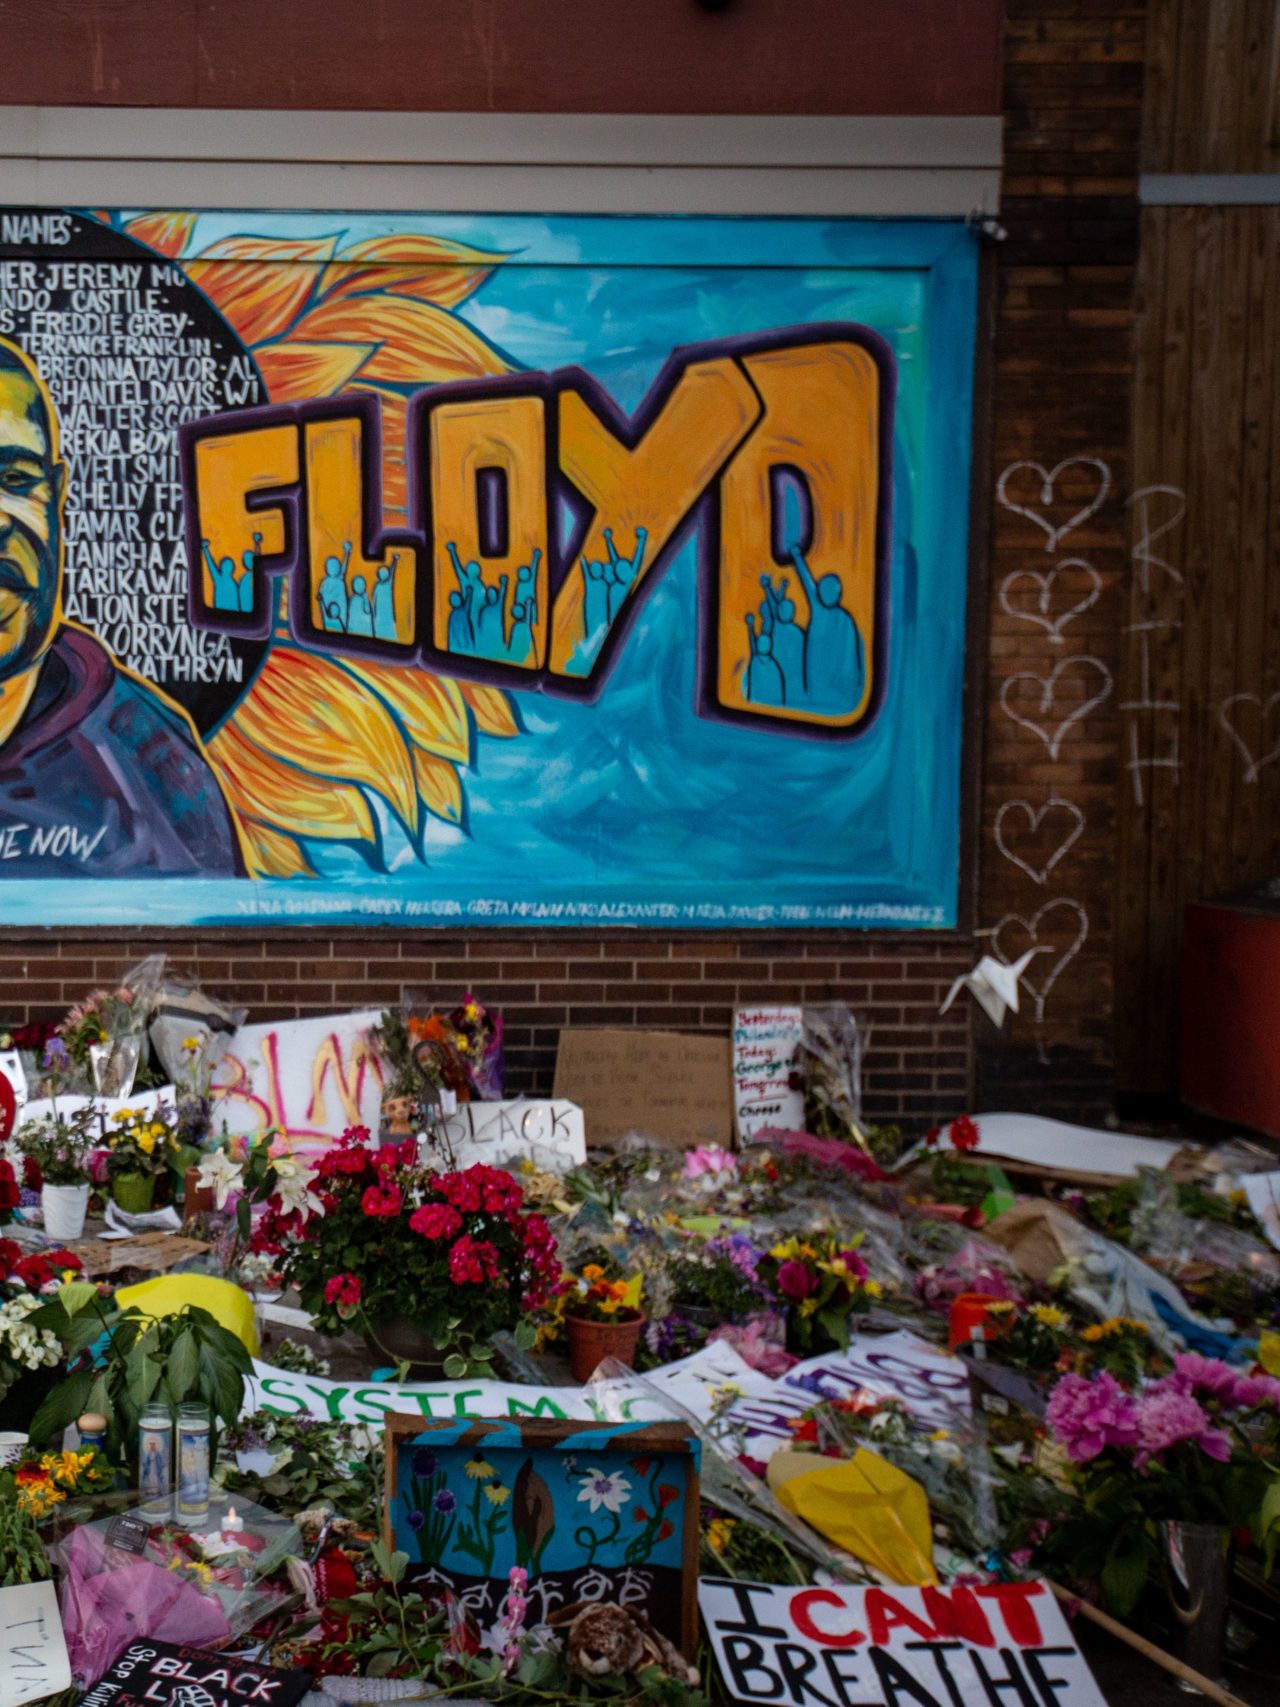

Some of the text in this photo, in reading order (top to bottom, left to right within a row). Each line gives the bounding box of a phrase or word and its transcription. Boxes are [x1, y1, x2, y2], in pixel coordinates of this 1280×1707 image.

[3, 214, 73, 245] NAMES
[44, 264, 142, 289] JEREMY
[72, 288, 163, 313] CASTILE
[31, 313, 123, 336] FREDDIE
[127, 314, 187, 337] GREY
[17, 333, 111, 355] TERRANCE
[50, 380, 150, 405] SHANTEL
[150, 381, 215, 406] DAVIS
[54, 405, 146, 430] WALTER
[60, 430, 122, 456] REKIA
[65, 483, 147, 511] SHELLY
[62, 511, 145, 541] JAMAR
[188, 330, 890, 737] FLOYD
[64, 541, 164, 570] TANISHA
[64, 568, 150, 595] TARIKA
[64, 594, 141, 624] ALTON
[126, 655, 243, 684] KATHRYN
[29, 825, 109, 862] NOW
[210, 1032, 383, 1145] BLM
[700, 1577, 788, 1639] I
[111, 1645, 158, 1679] Stop
[148, 1656, 284, 1702] BLACK
